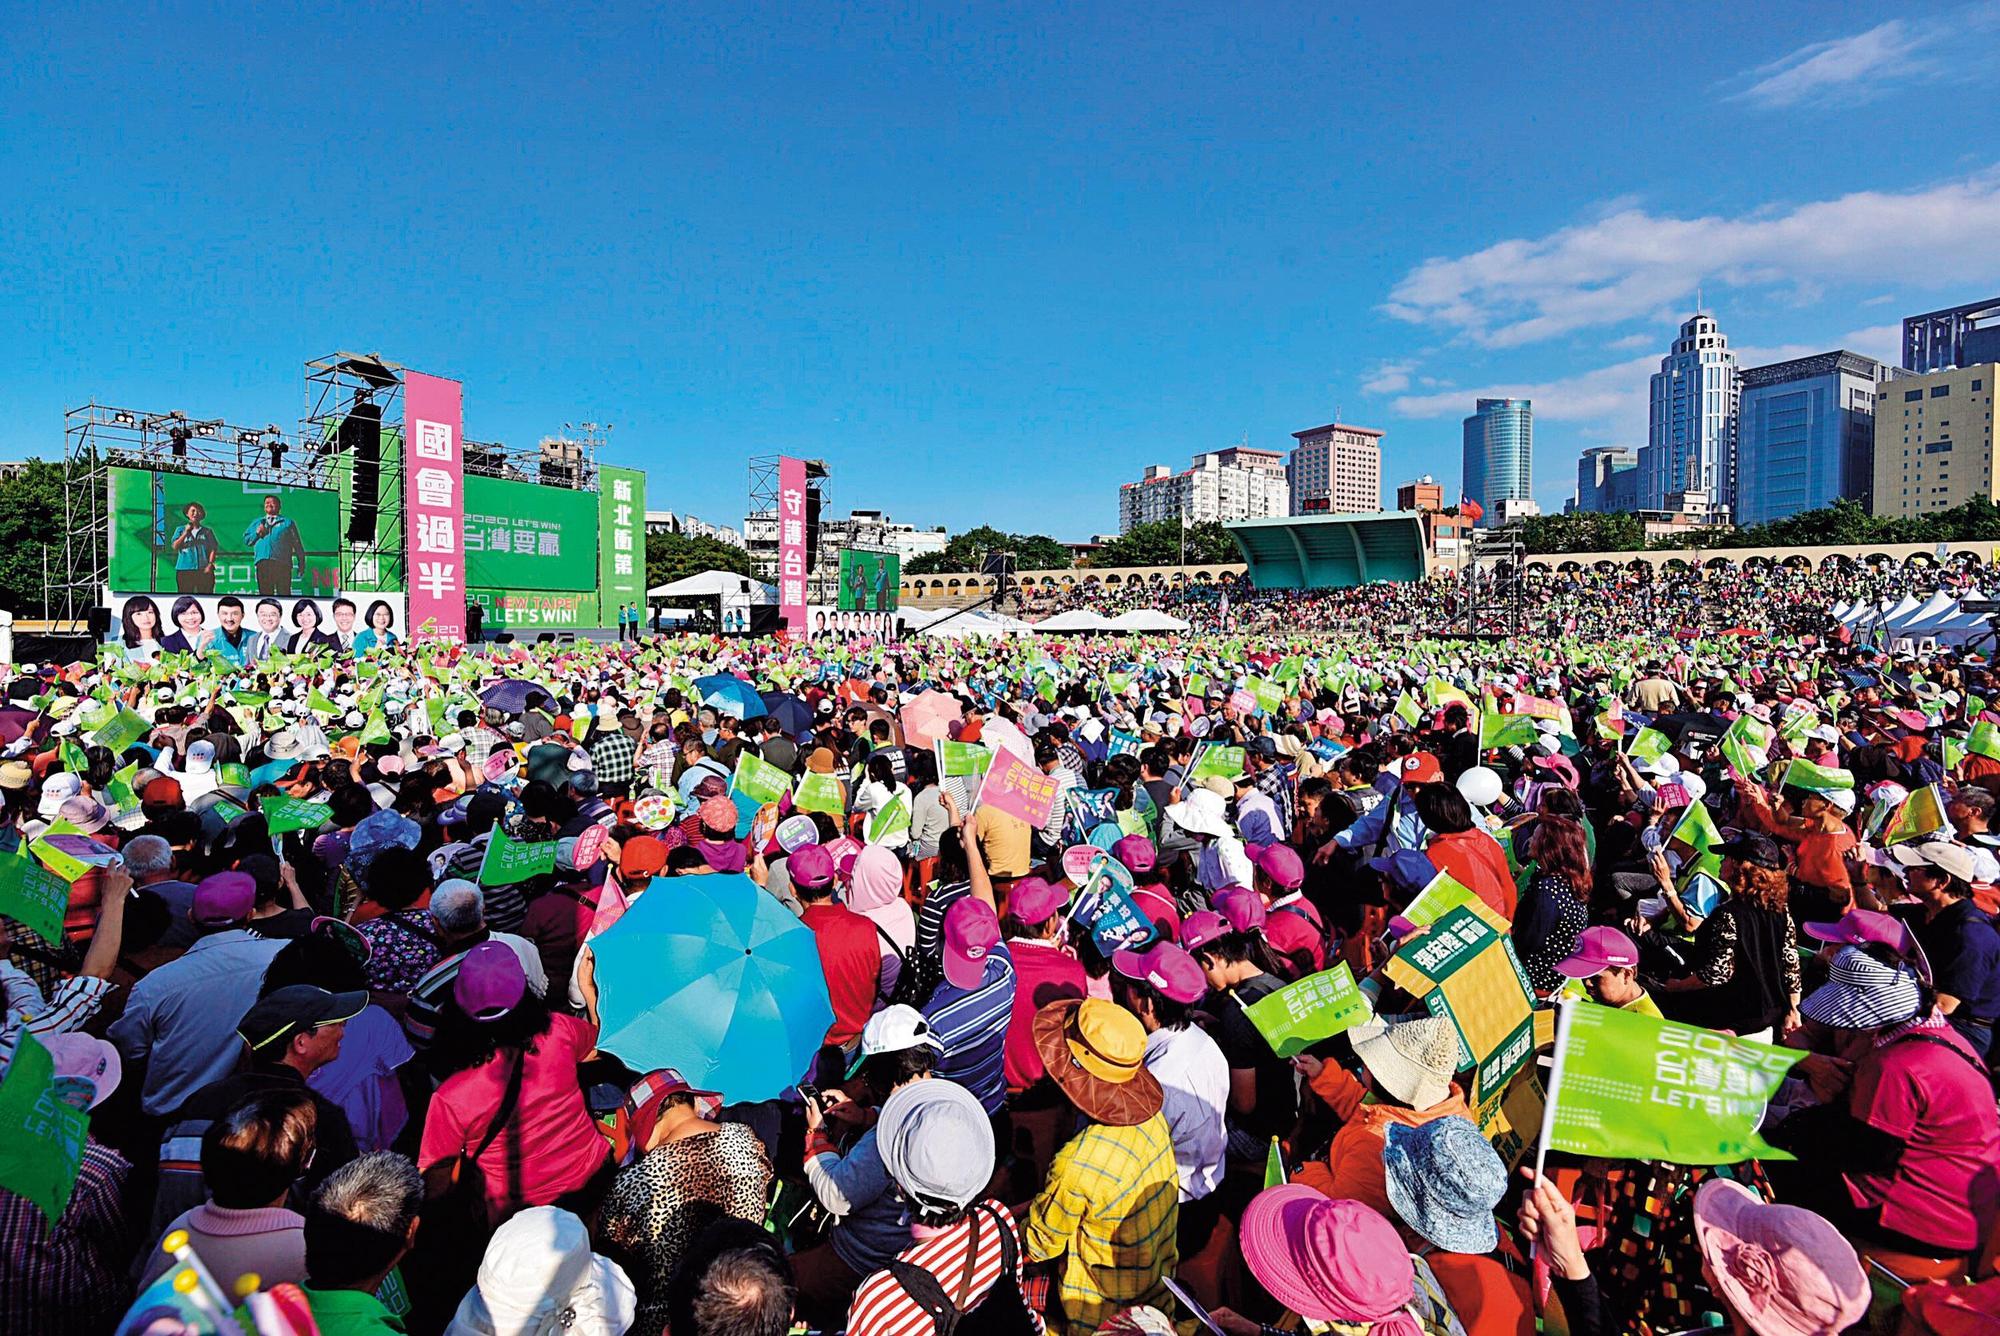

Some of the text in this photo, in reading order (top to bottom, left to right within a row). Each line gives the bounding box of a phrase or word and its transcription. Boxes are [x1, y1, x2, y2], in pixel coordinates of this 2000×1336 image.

[415, 419, 455, 600] 國會過半
[512, 518, 538, 529] LET'S
[540, 521, 561, 531] WIN!
[463, 525, 560, 557] 台灣要贏
[613, 479, 633, 591] 新北衝第一
[783, 488, 803, 606] 守護台灣
[495, 596, 529, 610] NEW
[533, 597, 577, 611] TAIPEI
[495, 608, 577, 624] LET'S WIN!
[1412, 931, 1464, 972] 張宏陸
[1282, 966, 1346, 1001] 2020
[1286, 976, 1351, 1016] 台灣要贏
[1292, 986, 1354, 1023] LET'S WIN!
[1657, 1025, 1797, 1072] 2020
[1650, 1085, 1722, 1115] LET'S
